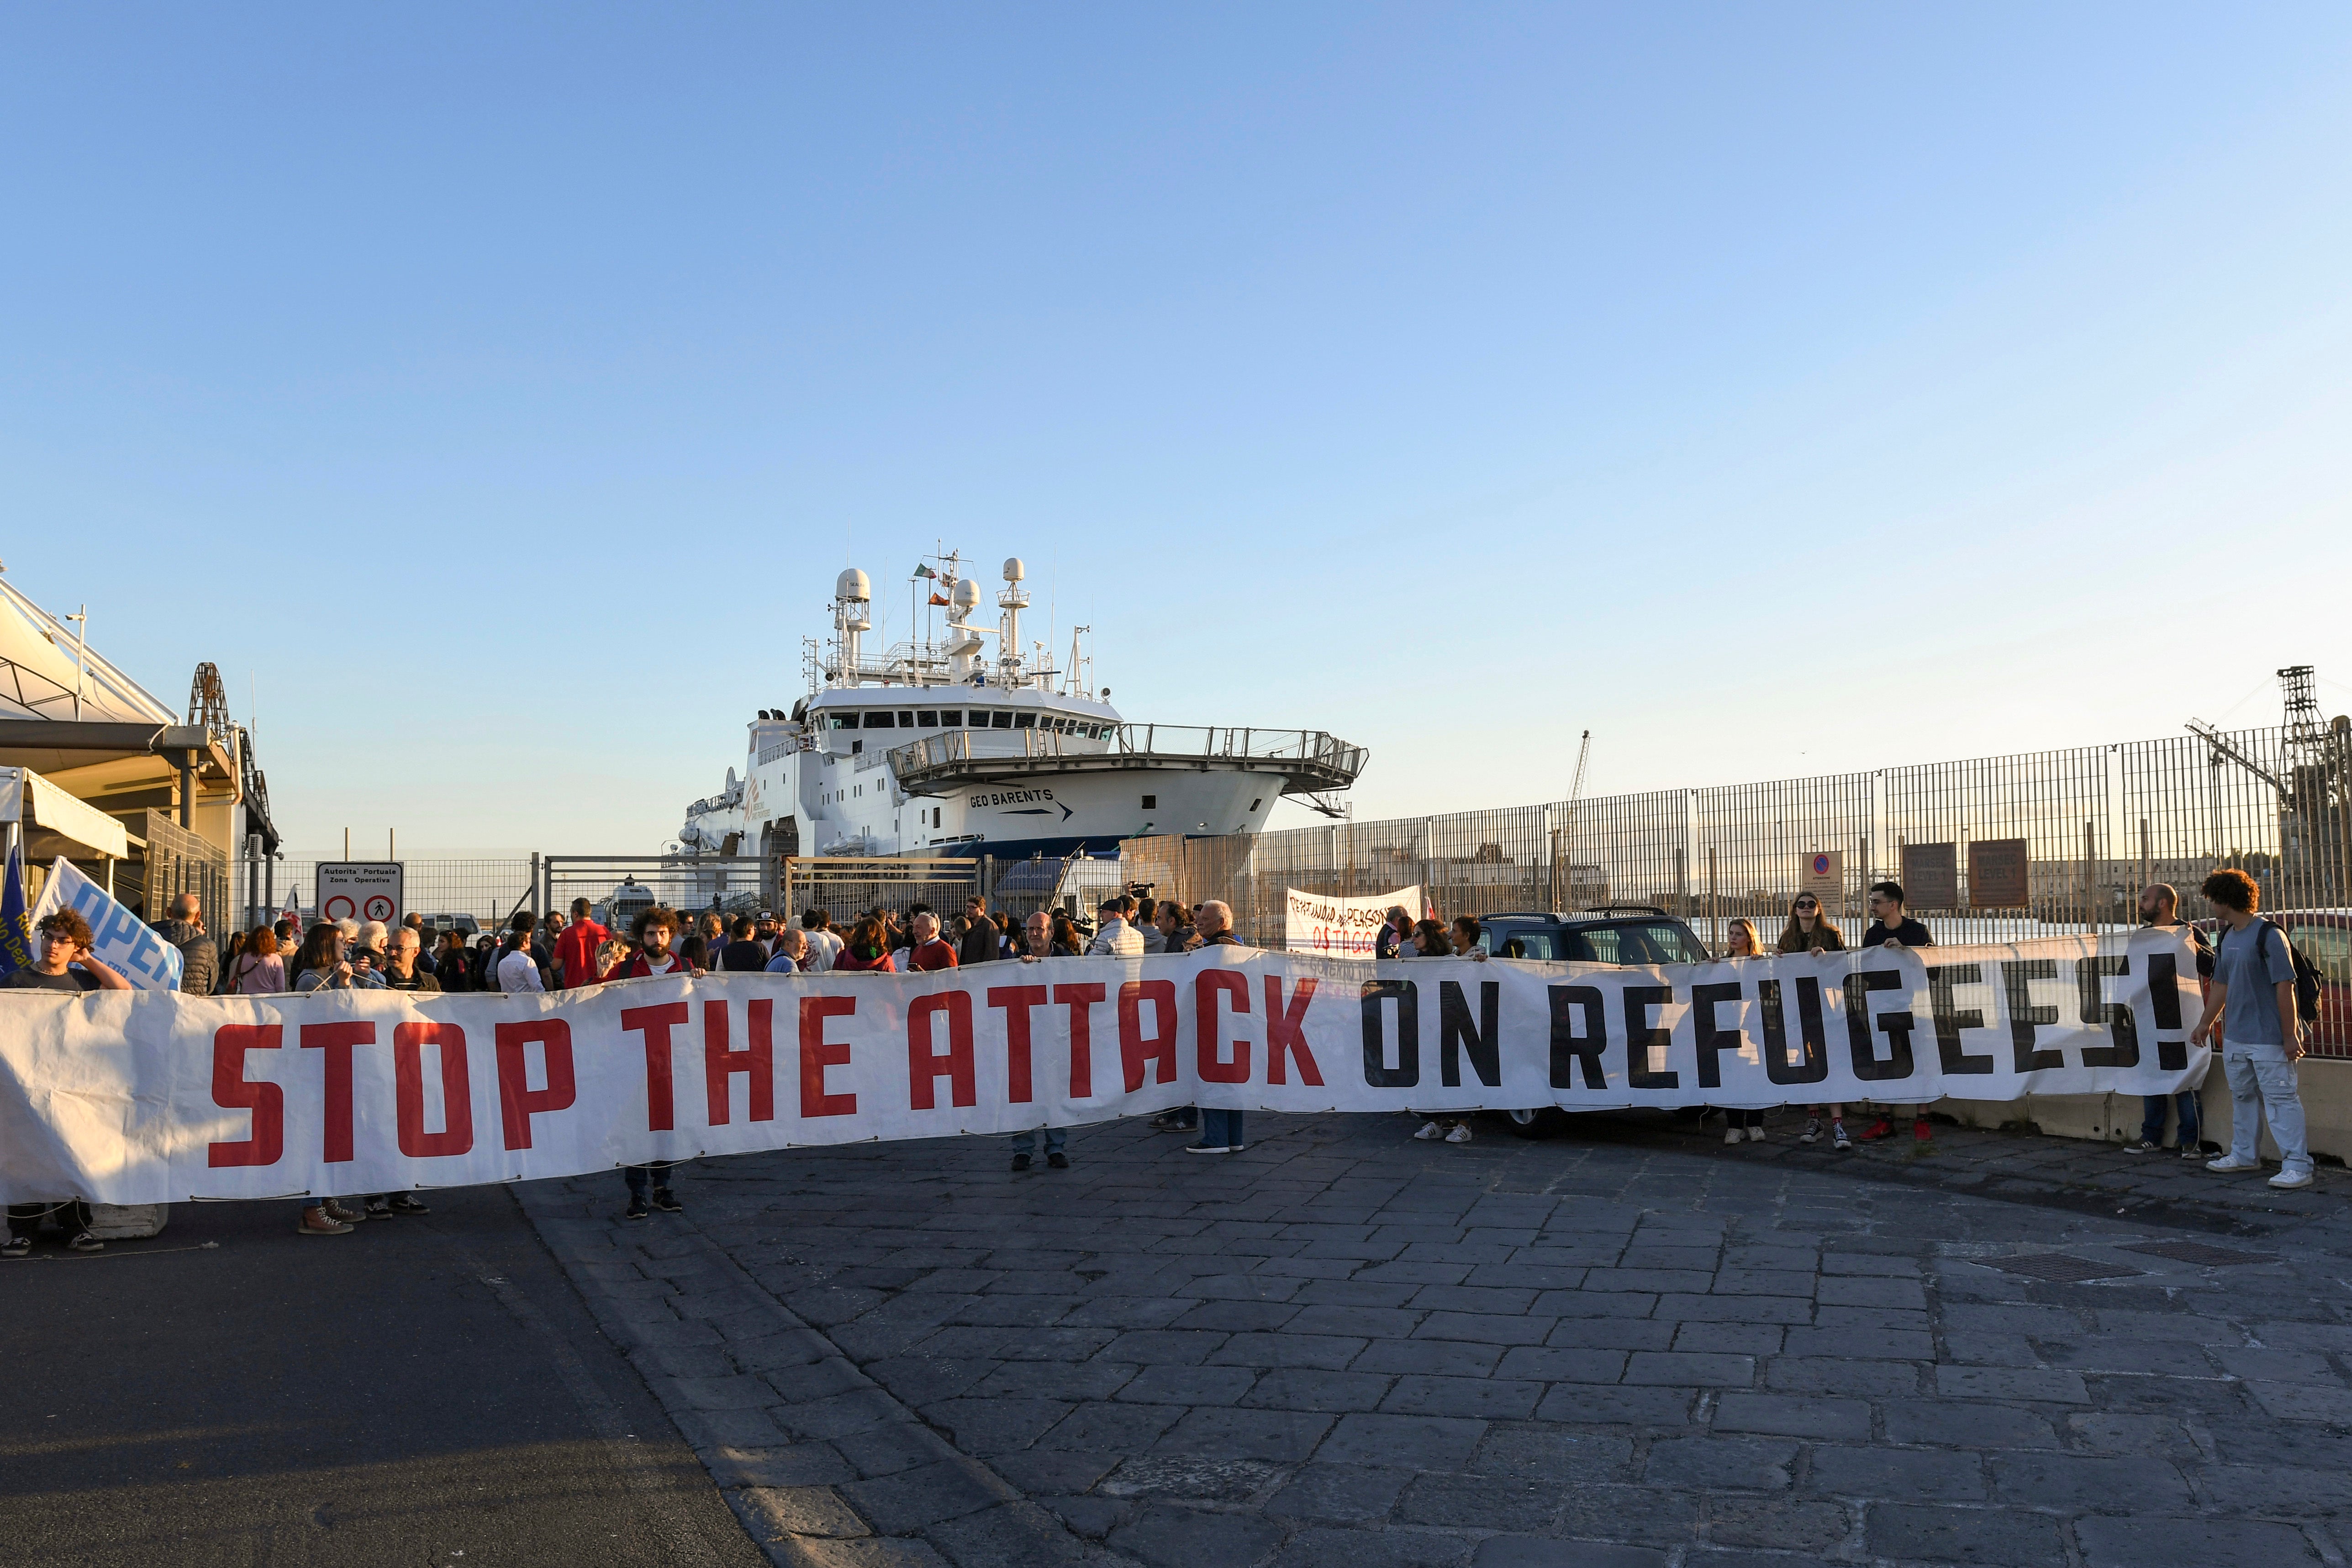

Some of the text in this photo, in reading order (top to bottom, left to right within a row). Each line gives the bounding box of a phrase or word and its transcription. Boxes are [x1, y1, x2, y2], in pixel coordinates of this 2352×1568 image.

[970, 789, 1054, 808] GEO BARENTS
[208, 953, 2188, 1168] STOP THE ATTACK ON REFUGEES!
